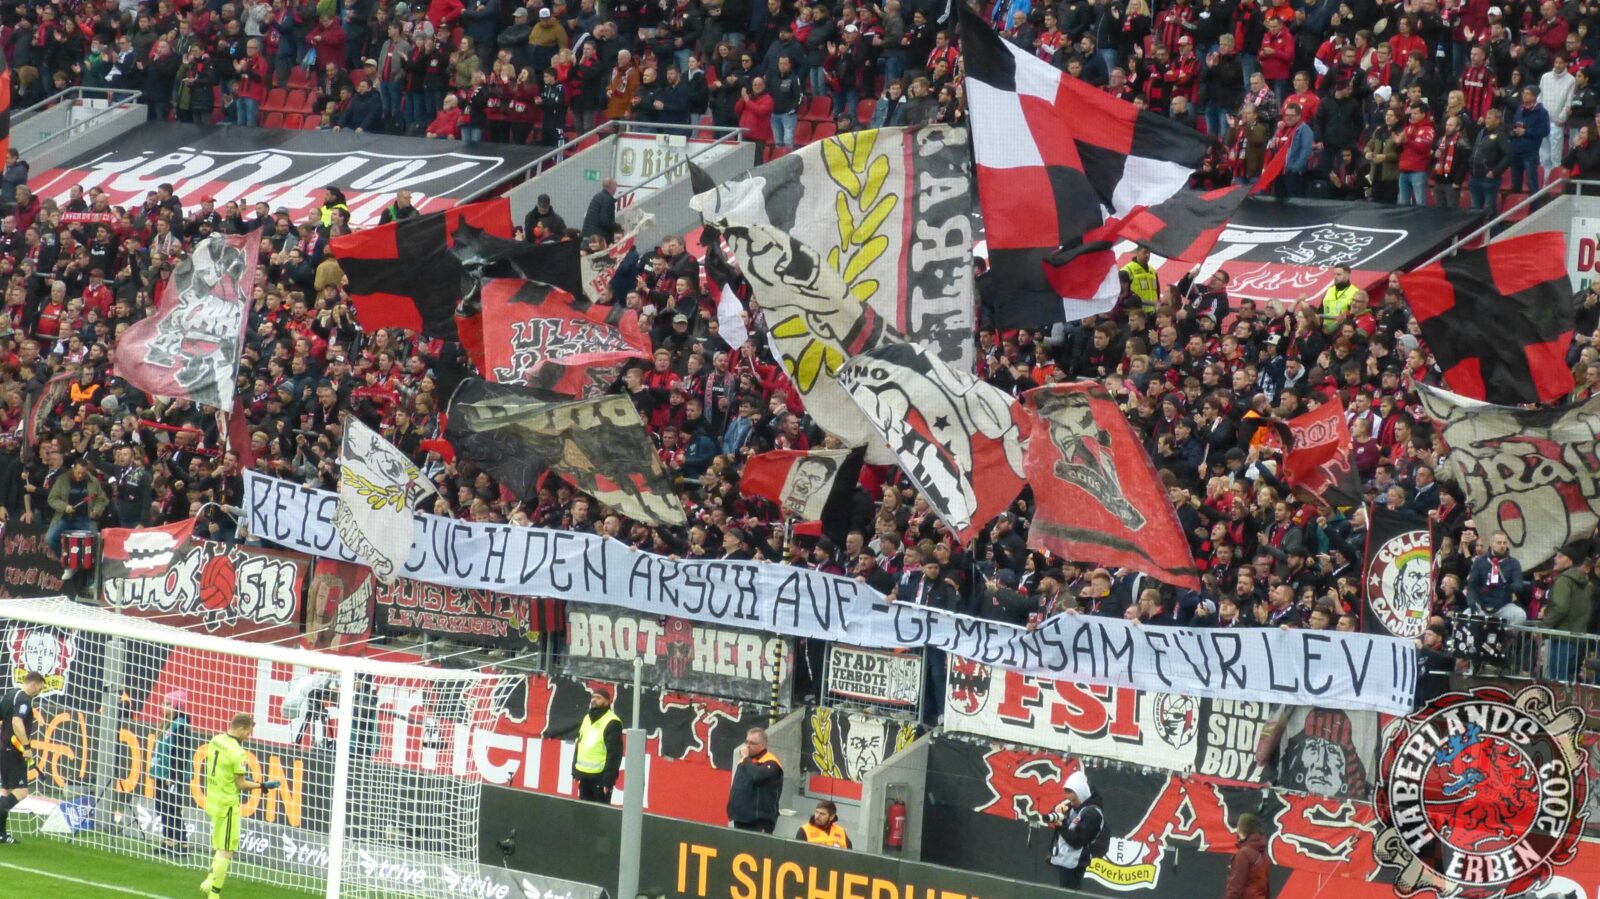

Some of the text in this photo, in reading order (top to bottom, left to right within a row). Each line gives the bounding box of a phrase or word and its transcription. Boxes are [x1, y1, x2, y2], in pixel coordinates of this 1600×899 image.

[240, 558, 296, 623] 513
[376, 578, 518, 619] JUGEND
[519, 531, 608, 595] DEN
[629, 553, 760, 621] ARSCH
[772, 570, 859, 632] AUF
[894, 604, 1134, 683] GEMEINSAM
[1144, 629, 1248, 690] FÜR
[1261, 631, 1374, 697] LEV
[388, 607, 509, 637] LEVERKUSEN
[568, 612, 789, 684] BROT HERS
[832, 650, 889, 674] STADT
[830, 682, 886, 698] AUFHEBEN
[832, 668, 888, 687] VERBOTE
[997, 670, 1145, 746] FSI
[677, 842, 717, 897] IT
